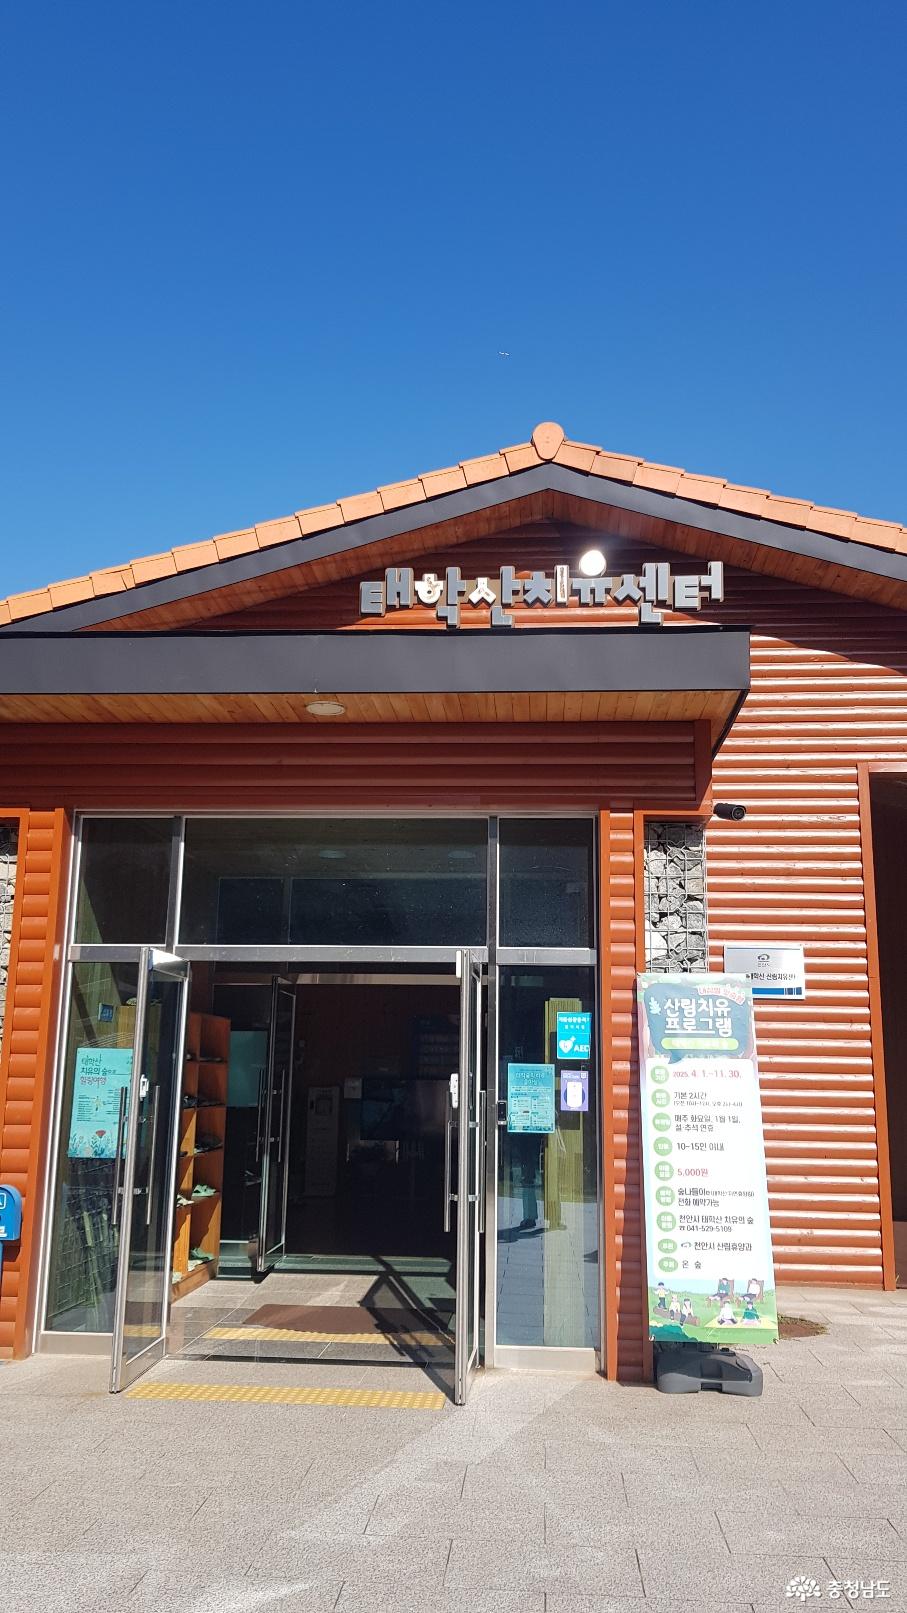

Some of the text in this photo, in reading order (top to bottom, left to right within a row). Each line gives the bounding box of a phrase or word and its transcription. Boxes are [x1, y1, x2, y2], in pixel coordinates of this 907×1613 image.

[359, 549, 724, 629] 태학산치유센터
[663, 997, 731, 1017] 산림치유
[665, 1017, 732, 1037] 프로그램
[673, 1091, 687, 1100] 기본
[688, 1091, 707, 1100] 2시간
[674, 1114, 688, 1122] 매주
[677, 1168, 709, 1177] 5,000원
[678, 1198, 691, 1207] 전화
[679, 1214, 700, 1224] 천안시
[724, 1215, 745, 1224] 치유의
[746, 1216, 755, 1225] 숲
[694, 1241, 715, 1251] 천안시
[694, 1260, 702, 1269] 숲
